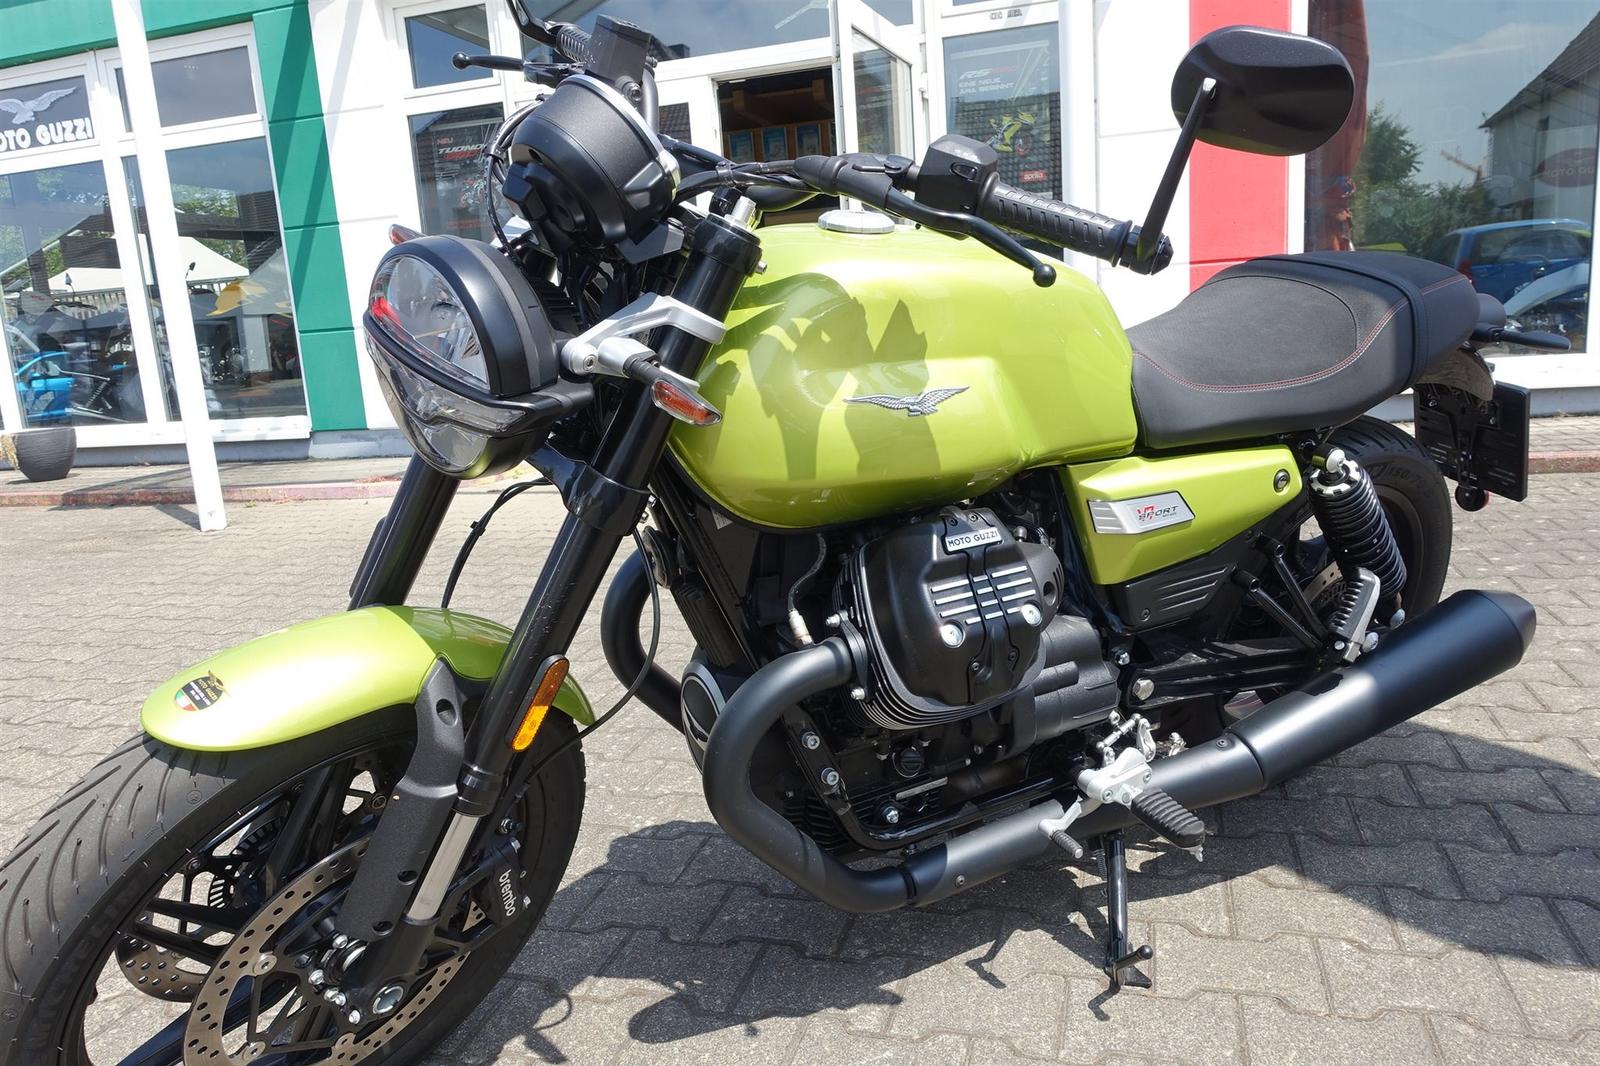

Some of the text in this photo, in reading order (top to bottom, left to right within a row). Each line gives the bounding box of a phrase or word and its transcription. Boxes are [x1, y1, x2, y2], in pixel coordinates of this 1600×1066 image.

[36, 117, 94, 145] GUZZI
[1138, 505, 1178, 520] SPORT
[948, 530, 998, 548] MOTO GUZZI
[499, 869, 517, 916] brembo
